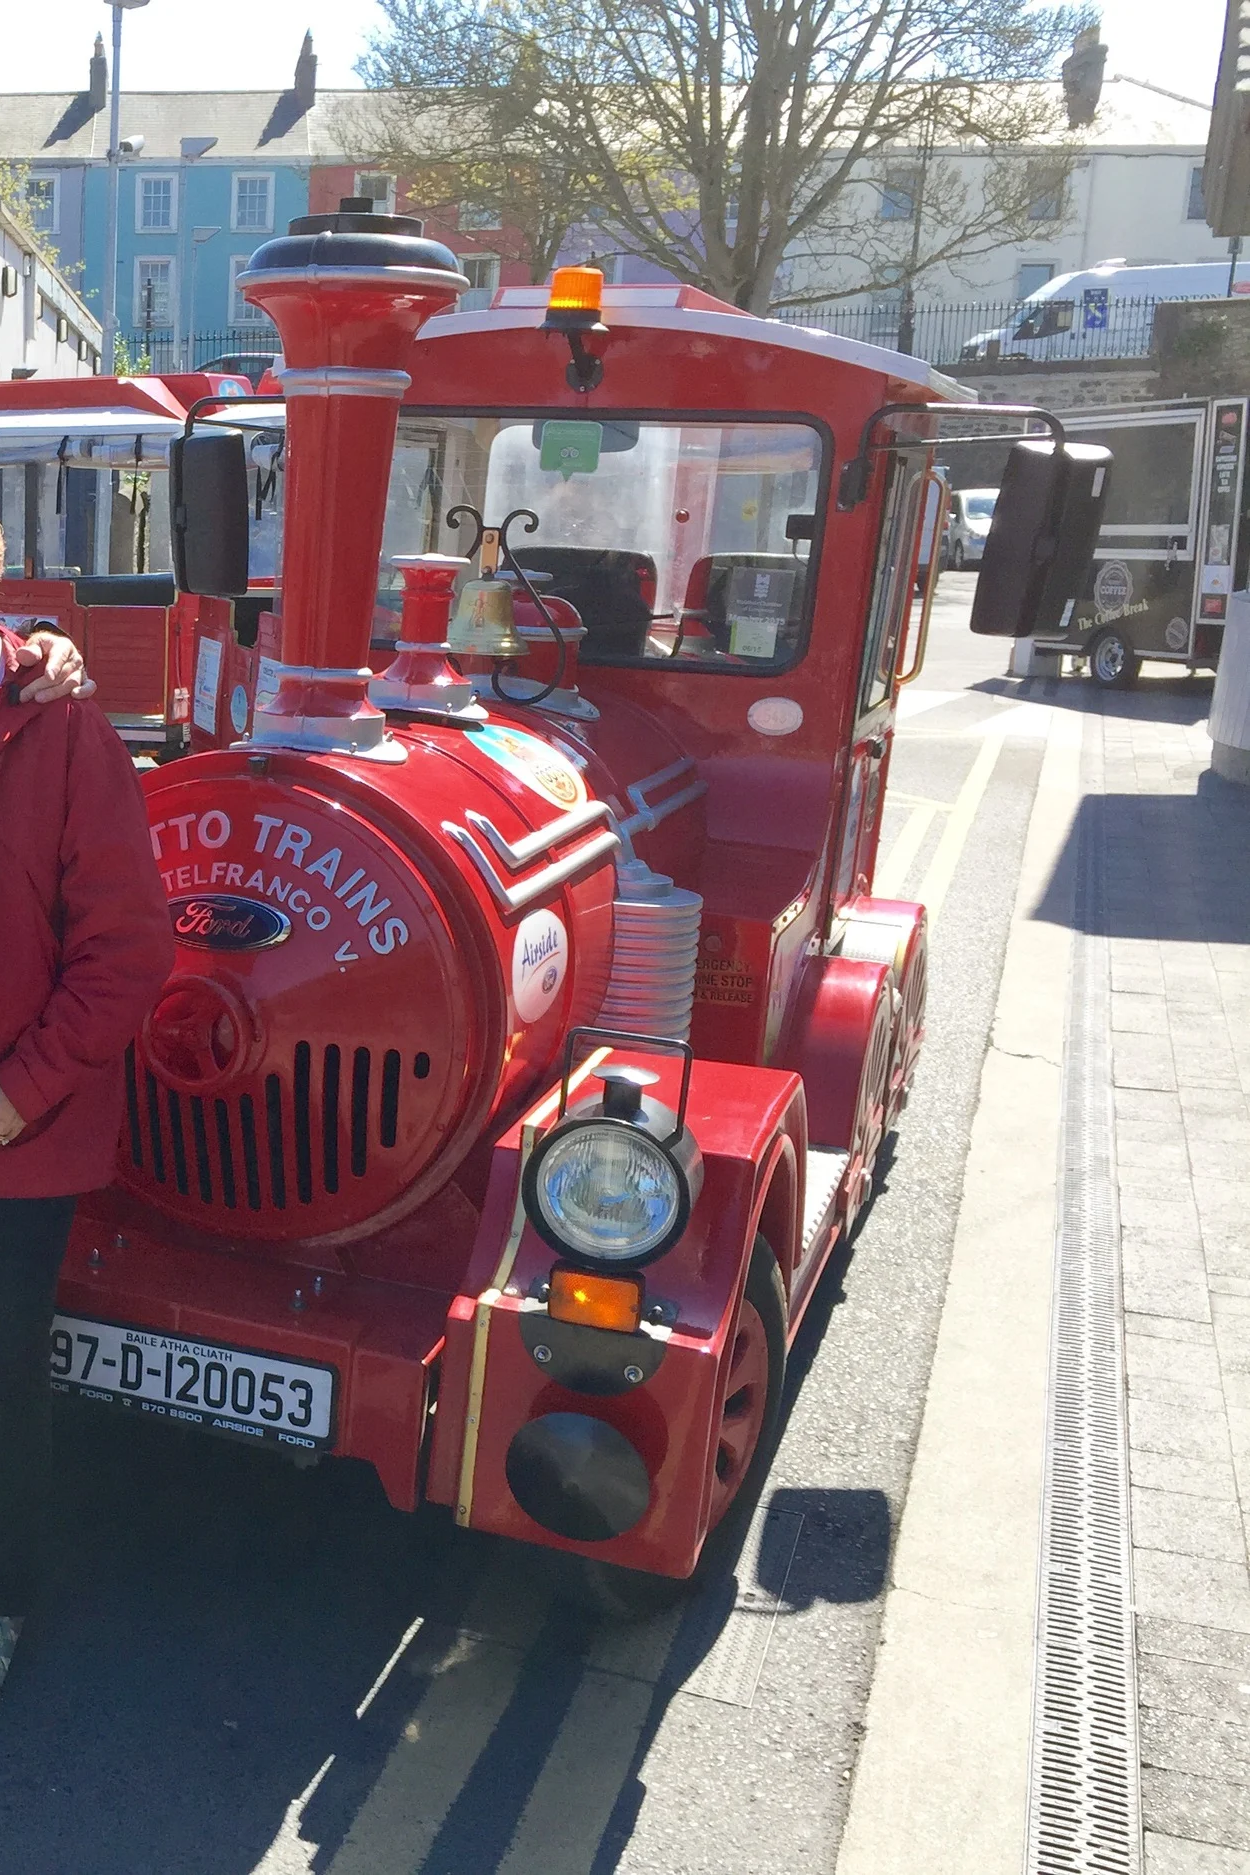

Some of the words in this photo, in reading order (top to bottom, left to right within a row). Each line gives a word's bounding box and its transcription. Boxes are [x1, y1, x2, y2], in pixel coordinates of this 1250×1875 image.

[1100, 585, 1127, 596] COFFEE
[1077, 616, 1093, 631] The
[1123, 598, 1149, 617] Break
[149, 810, 231, 861] TTO
[253, 814, 410, 955] TRAINS
[161, 861, 332, 932] TELFRANCO
[175, 901, 255, 938] Ford
[522, 926, 558, 973] Airside
[697, 959, 751, 972] ERGENCY
[695, 974, 719, 986] INE
[721, 975, 753, 988] STOP
[710, 990, 753, 1003] RELEASE
[126, 1332, 157, 1347] BAILE
[192, 1346, 233, 1362] CLIATH
[51, 1329, 313, 1428] 97-D-120053
[80, 1388, 113, 1402] FORD
[141, 1402, 166, 1414] 870
[212, 1418, 264, 1437] AIRSIDE
[278, 1433, 316, 1448] FORD
